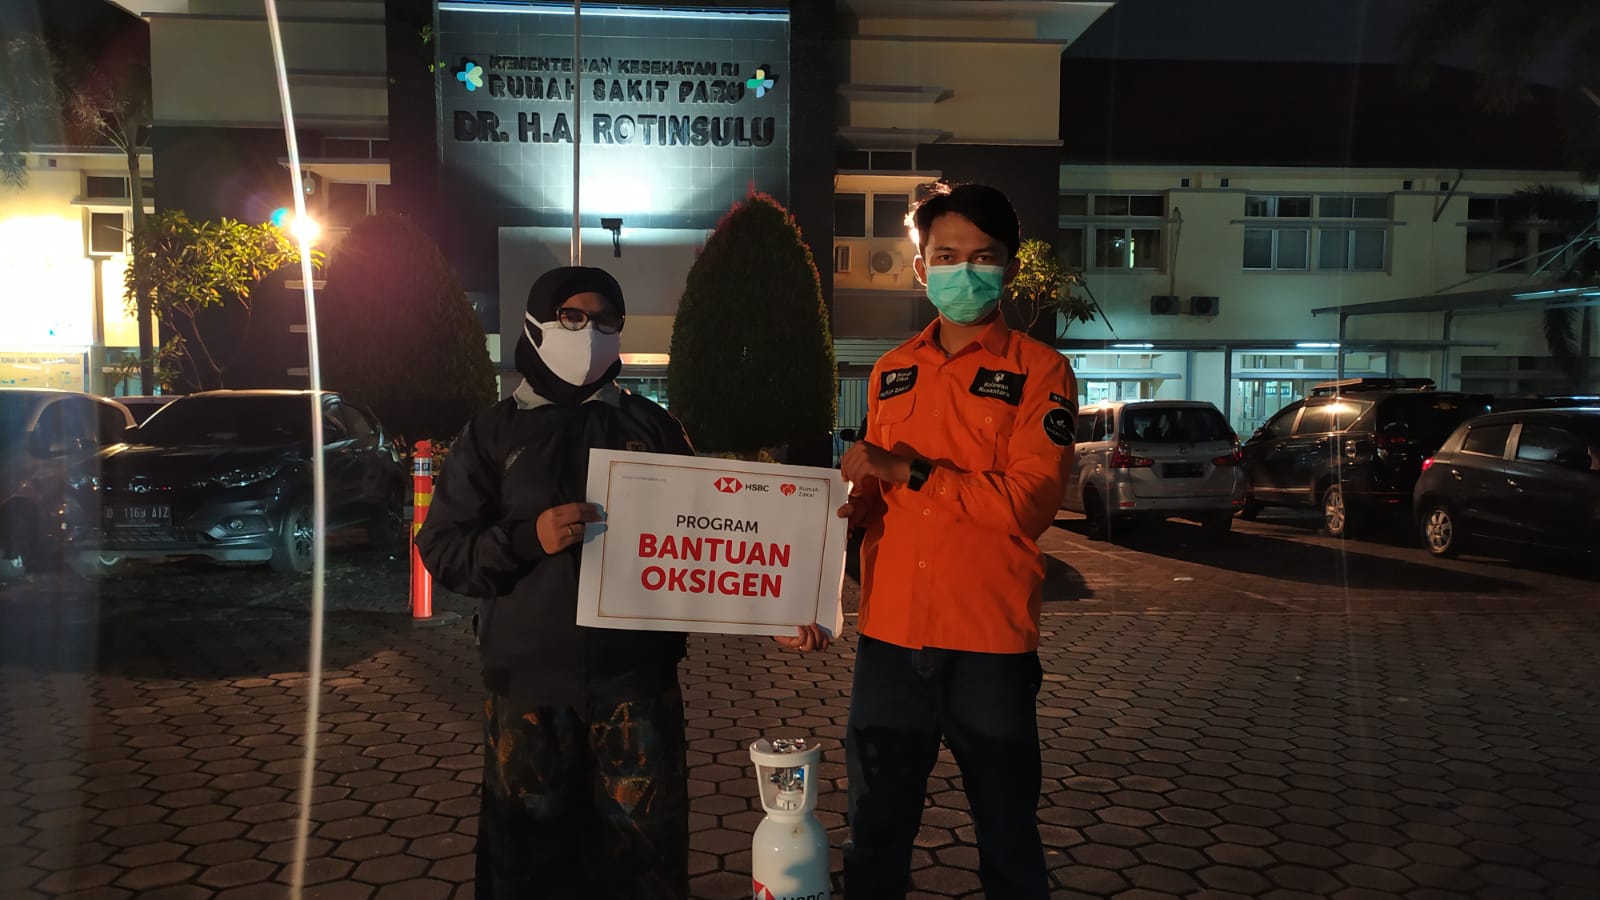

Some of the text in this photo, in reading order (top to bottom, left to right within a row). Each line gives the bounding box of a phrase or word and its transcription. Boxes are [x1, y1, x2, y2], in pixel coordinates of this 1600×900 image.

[490, 55, 740, 77] KEMENTERIAN KESEHATAN RI
[488, 74, 745, 104] RUMAH SAKIT PARU
[453, 110, 510, 143] DR.
[592, 113, 775, 148] ROTINSULU
[978, 387, 1010, 398] Nusantara
[745, 483, 769, 493] HSBC
[676, 514, 758, 534] PROGRAM
[638, 533, 791, 568] BANTUAN
[640, 565, 782, 598] OKSIGEN
